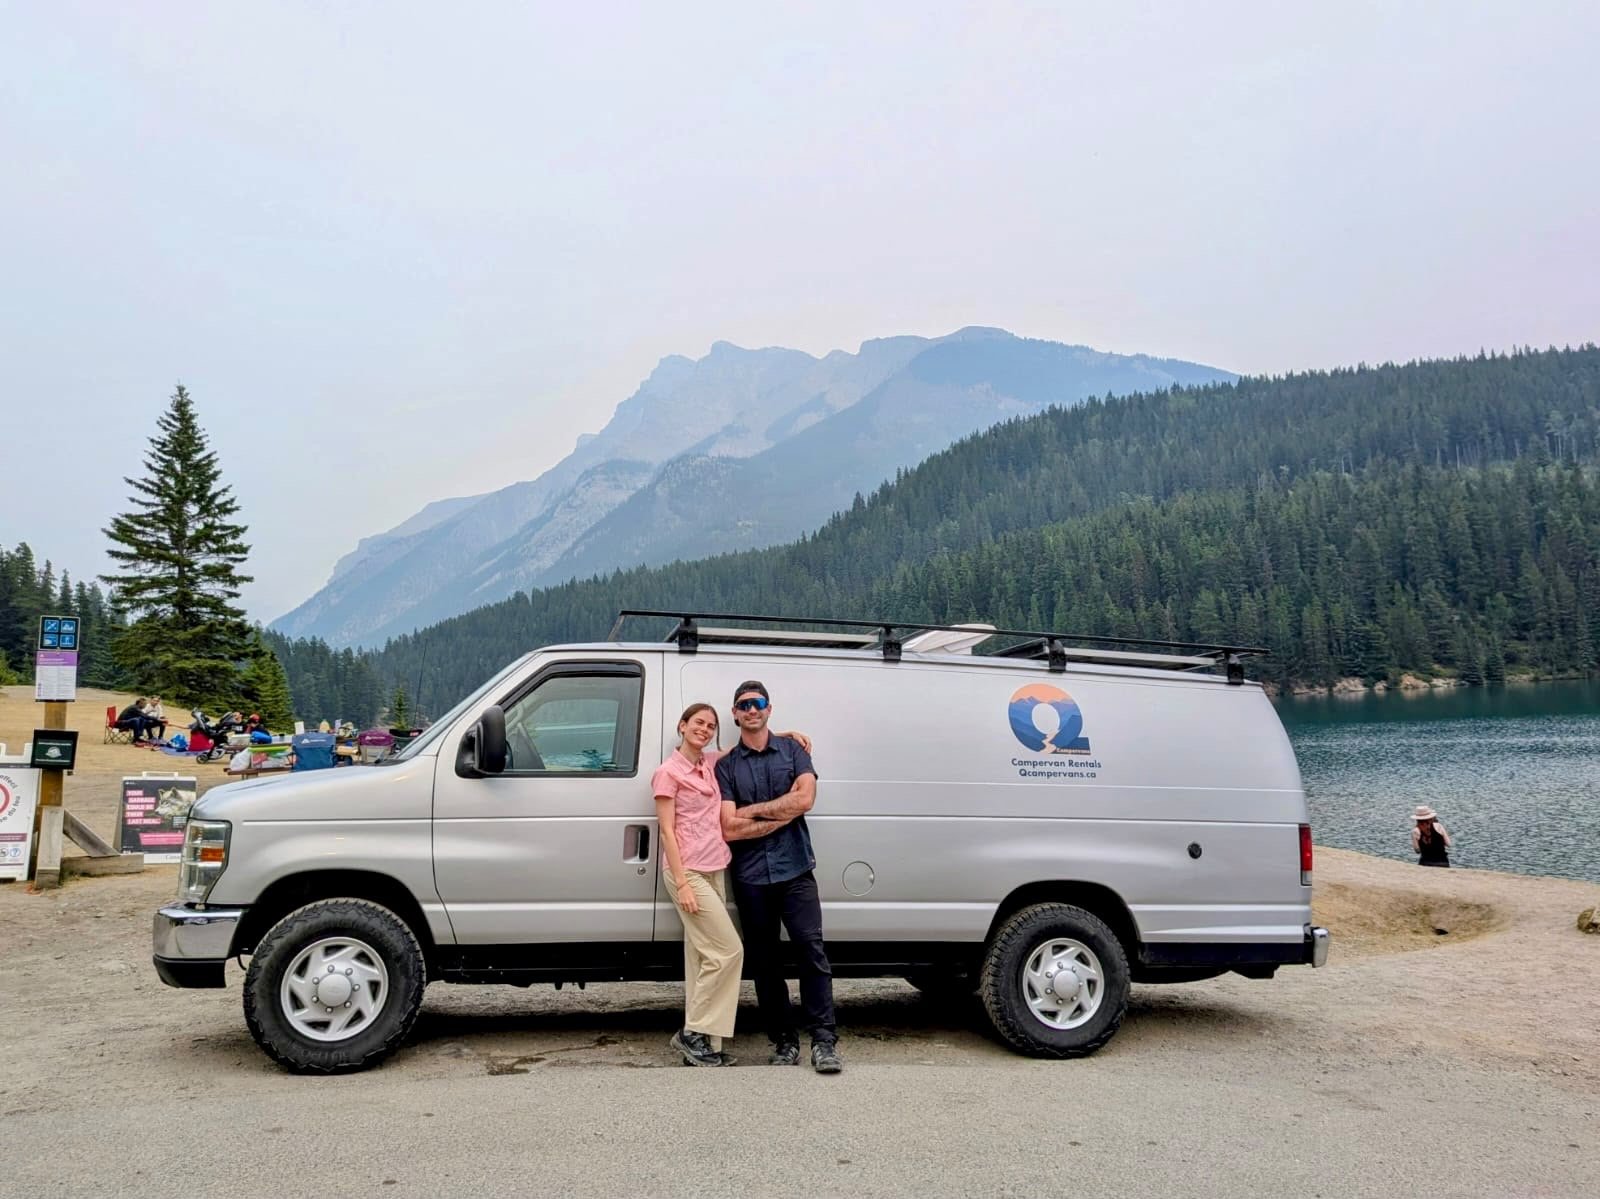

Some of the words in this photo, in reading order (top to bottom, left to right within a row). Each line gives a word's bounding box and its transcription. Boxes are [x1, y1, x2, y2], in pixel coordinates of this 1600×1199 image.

[1011, 758, 1066, 769] Campervan
[1068, 759, 1102, 769] Rentals
[1018, 768, 1097, 779] Qcampervans.ca
